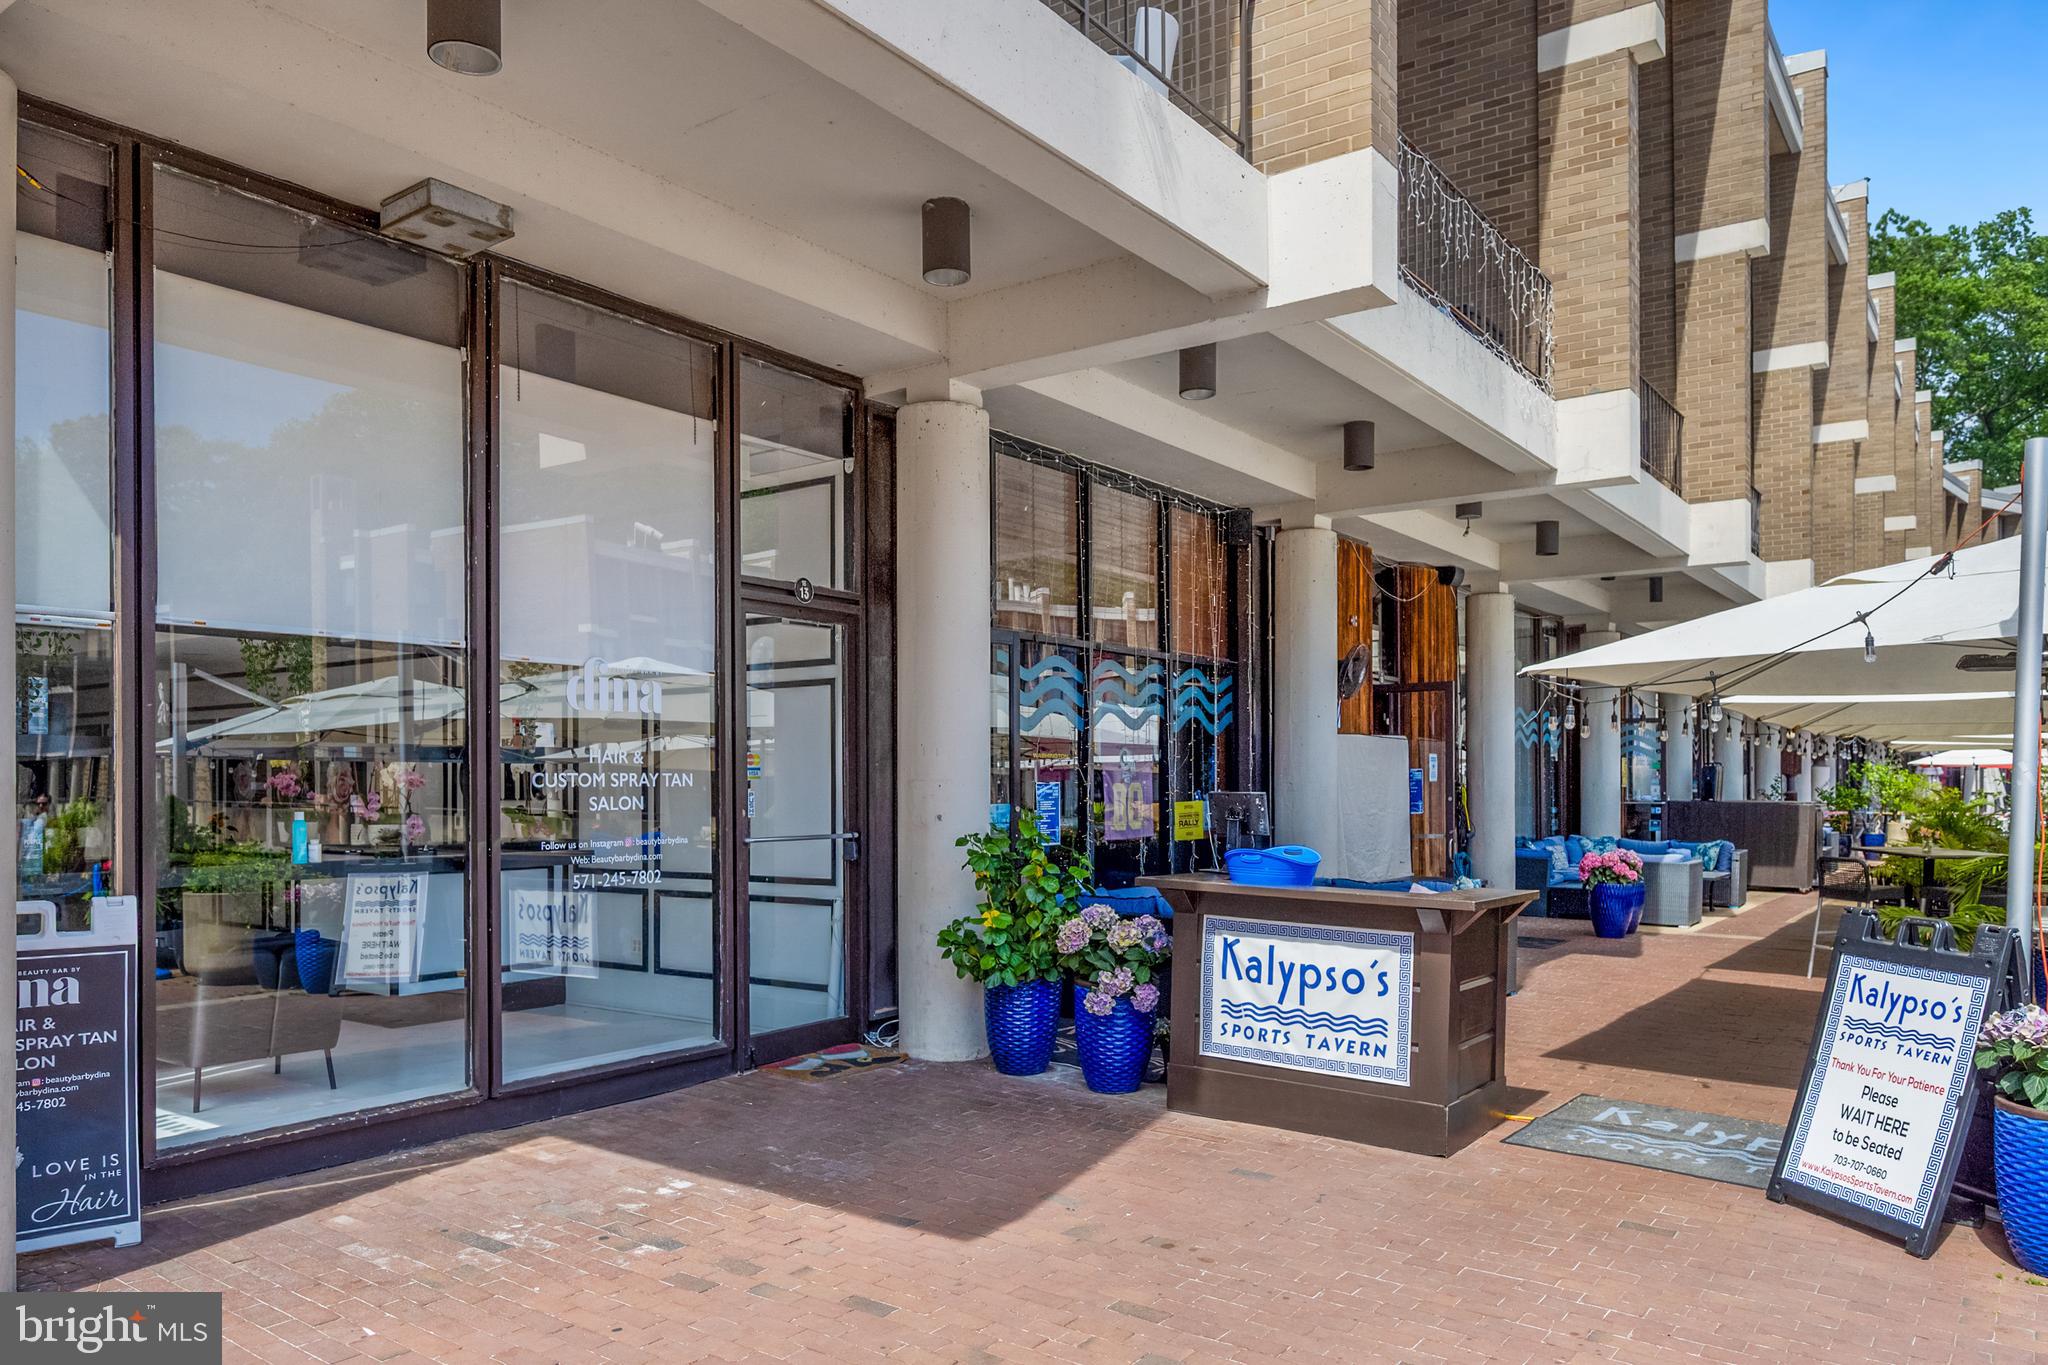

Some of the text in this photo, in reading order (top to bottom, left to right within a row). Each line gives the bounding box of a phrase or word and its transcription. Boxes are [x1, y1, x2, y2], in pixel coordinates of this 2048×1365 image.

[800, 586, 810, 600] 13
[566, 656, 662, 714] dina
[590, 750, 644, 764] HAIR &
[532, 772, 694, 788] CUSTOM SPRAY TAN
[589, 795, 644, 812] SALON
[1178, 819, 1200, 828] RALLY
[541, 840, 566, 850] Follow
[590, 840, 624, 850] Instagram
[636, 836, 688, 847] beautybarbydina
[570, 853, 662, 866] Web: Beautybarbydina.com
[572, 870, 662, 890] 571-245-7802
[18, 968, 50, 976] BEAUTY
[1221, 936, 1389, 1006] Kalypso's
[1849, 973, 1963, 1024] Kalypso's
[42, 1017, 56, 1030] &
[16, 1030, 118, 1052] SPRAY TAN
[1220, 1022, 1388, 1058] SPORTS TAVERN
[1840, 1031, 1952, 1066] SPORTS TAVERN
[46, 1071, 110, 1084] beautybarbydina
[1832, 1056, 1945, 1096] Thank You For Your Patience
[1861, 1086, 1898, 1108] Please
[1840, 1104, 1910, 1138] WAIT HERE
[1561, 1134, 1712, 1164] SPORTS
[1832, 1128, 1904, 1161] to be Seated
[32, 1154, 120, 1178] LOVE IS
[84, 1169, 122, 1182] IN THE
[1833, 1154, 1888, 1180] 703-707-0660
[1802, 1160, 1912, 1204] www.KalypsosSportsTavern.com
[31, 1184, 124, 1222] Hair
